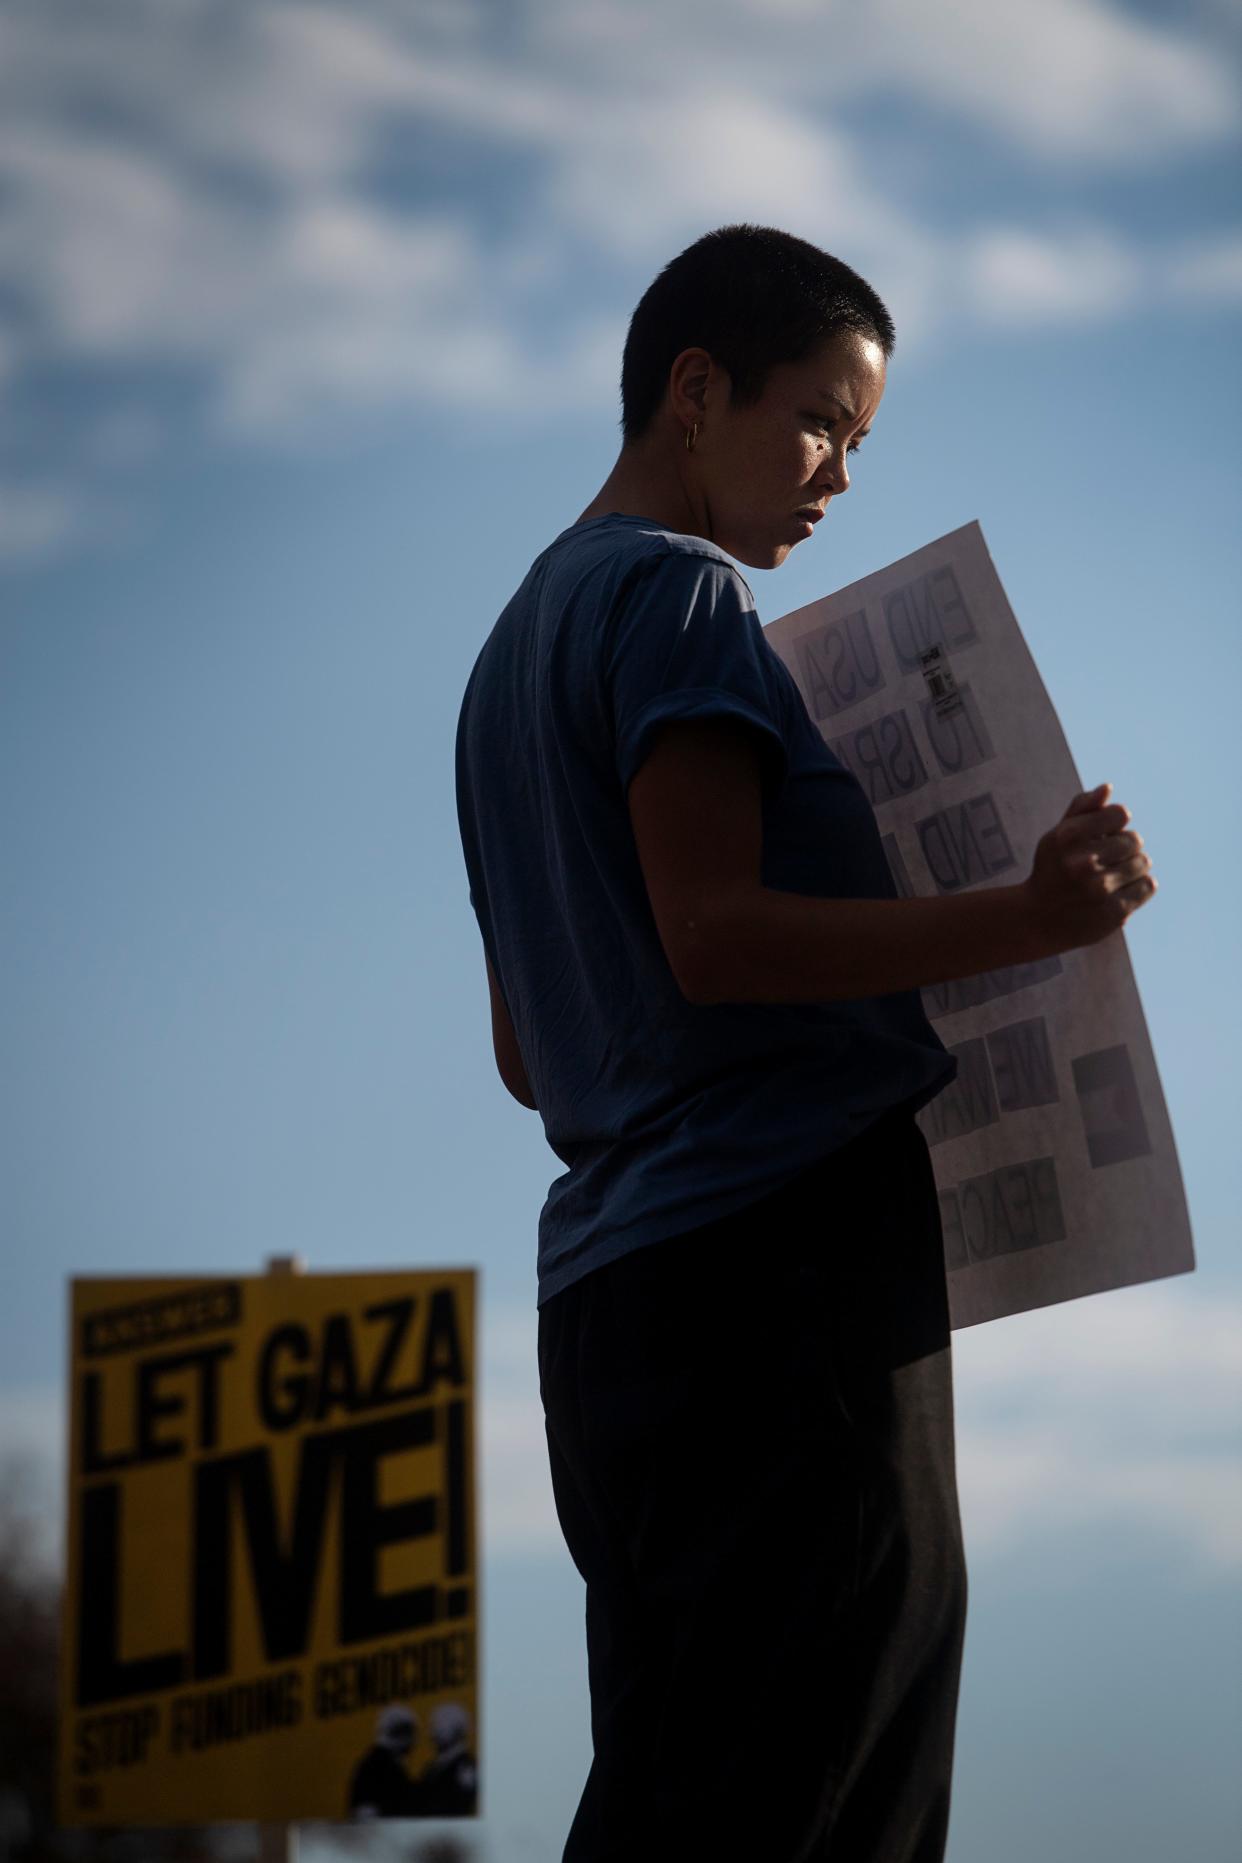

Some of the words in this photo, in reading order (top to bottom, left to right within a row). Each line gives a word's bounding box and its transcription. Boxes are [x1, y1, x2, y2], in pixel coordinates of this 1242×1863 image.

[82, 1338, 235, 1474] LET
[257, 1286, 465, 1432] GAZA
[77, 1397, 468, 1704] LIVE!
[75, 1705, 158, 1774] STOP
[171, 1672, 301, 1754] FUNDING
[316, 1632, 470, 1718] GENOCIDE!
